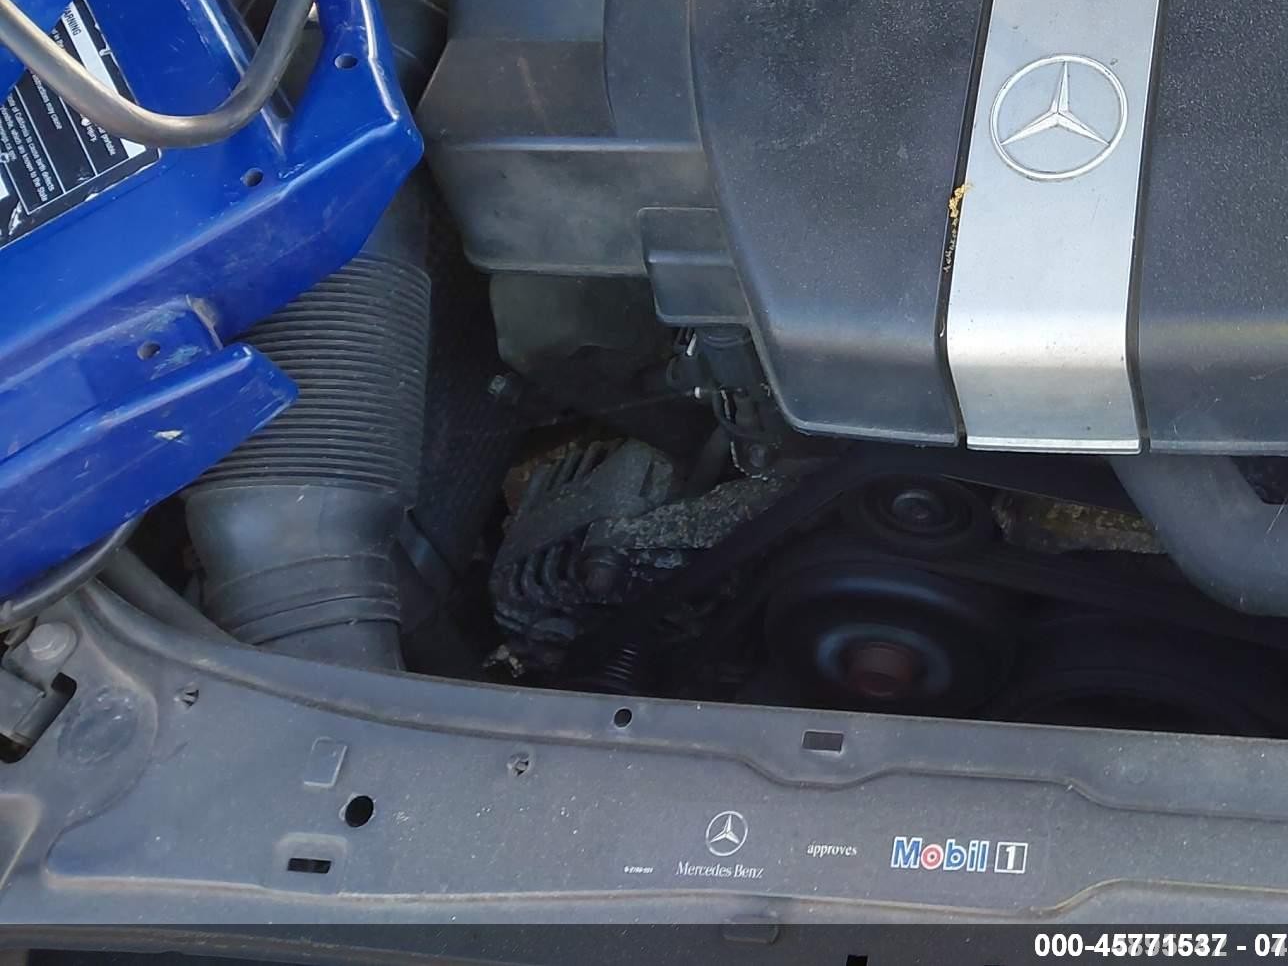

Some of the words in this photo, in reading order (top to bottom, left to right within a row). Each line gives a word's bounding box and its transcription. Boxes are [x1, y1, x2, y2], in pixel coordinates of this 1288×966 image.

[64, 6, 82, 36] ARNING
[807, 840, 858, 857] approves
[891, 836, 991, 872] Mobil
[675, 861, 732, 878] Mercedes
[733, 864, 764, 879] Benz
